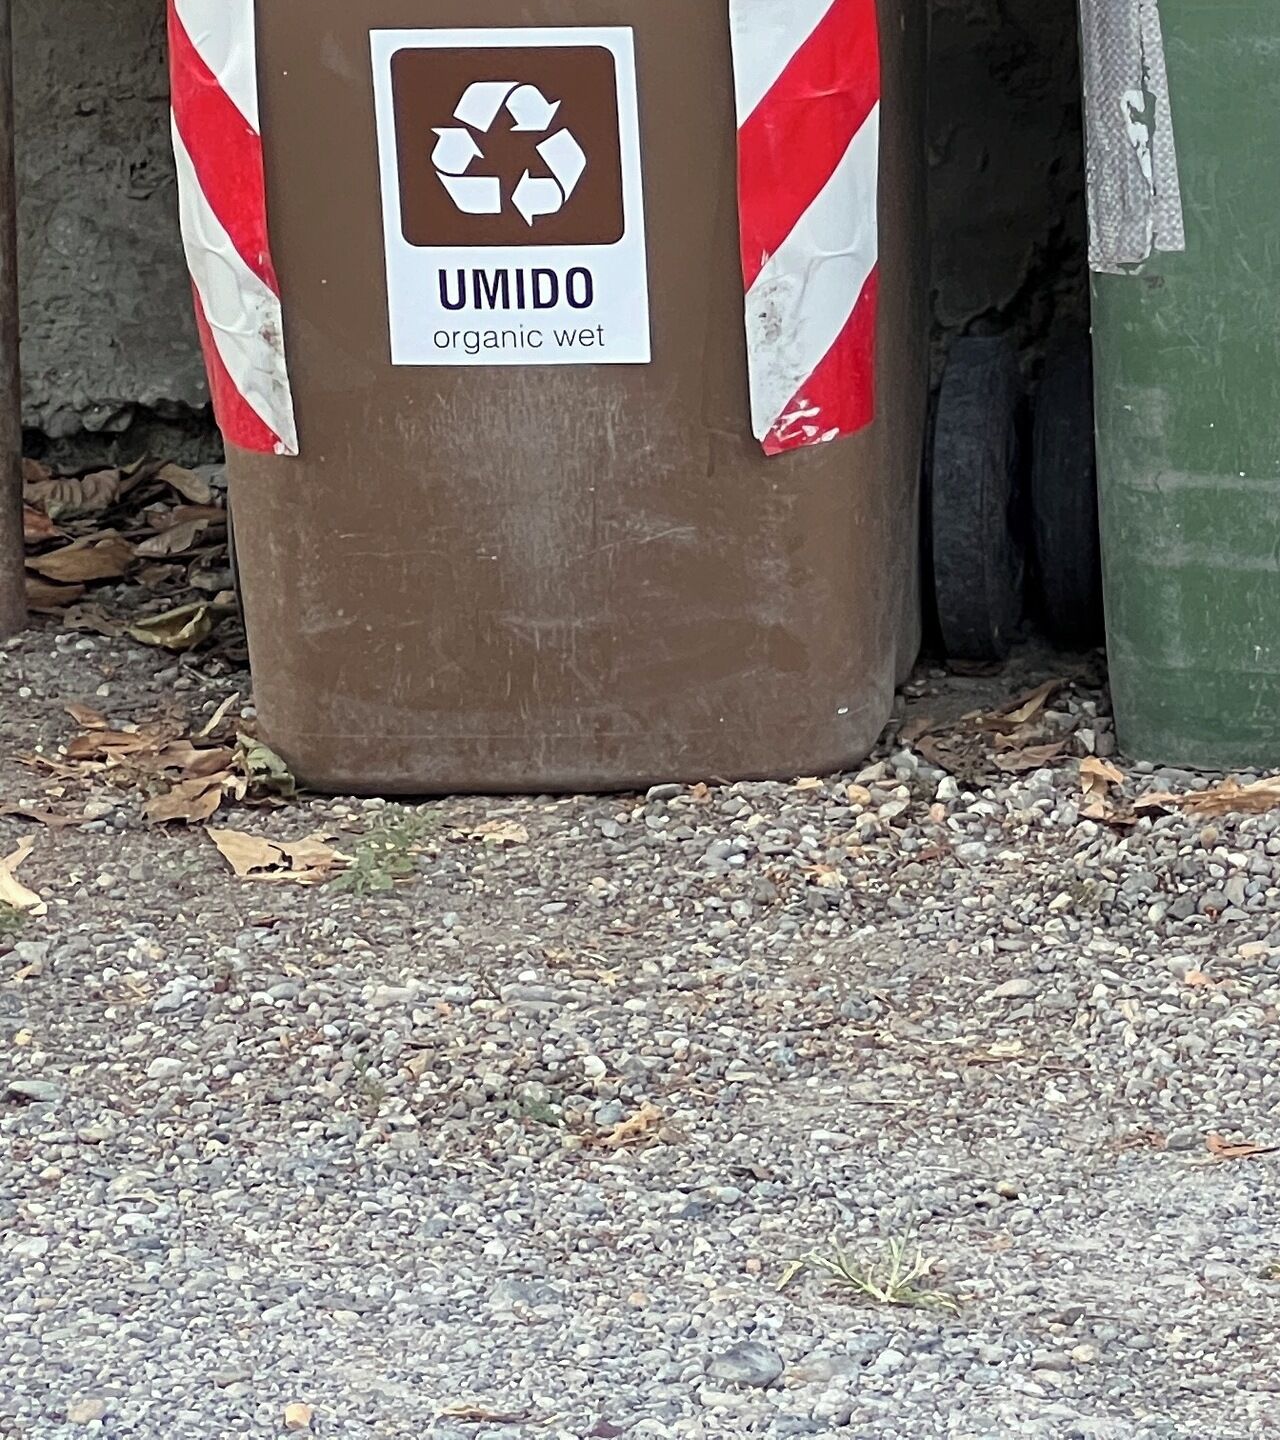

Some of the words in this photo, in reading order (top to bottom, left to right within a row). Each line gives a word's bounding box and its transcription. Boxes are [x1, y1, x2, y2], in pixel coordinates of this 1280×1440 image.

[438, 267, 595, 310] UMIDO
[433, 324, 544, 355] organic
[555, 324, 606, 348] wet
